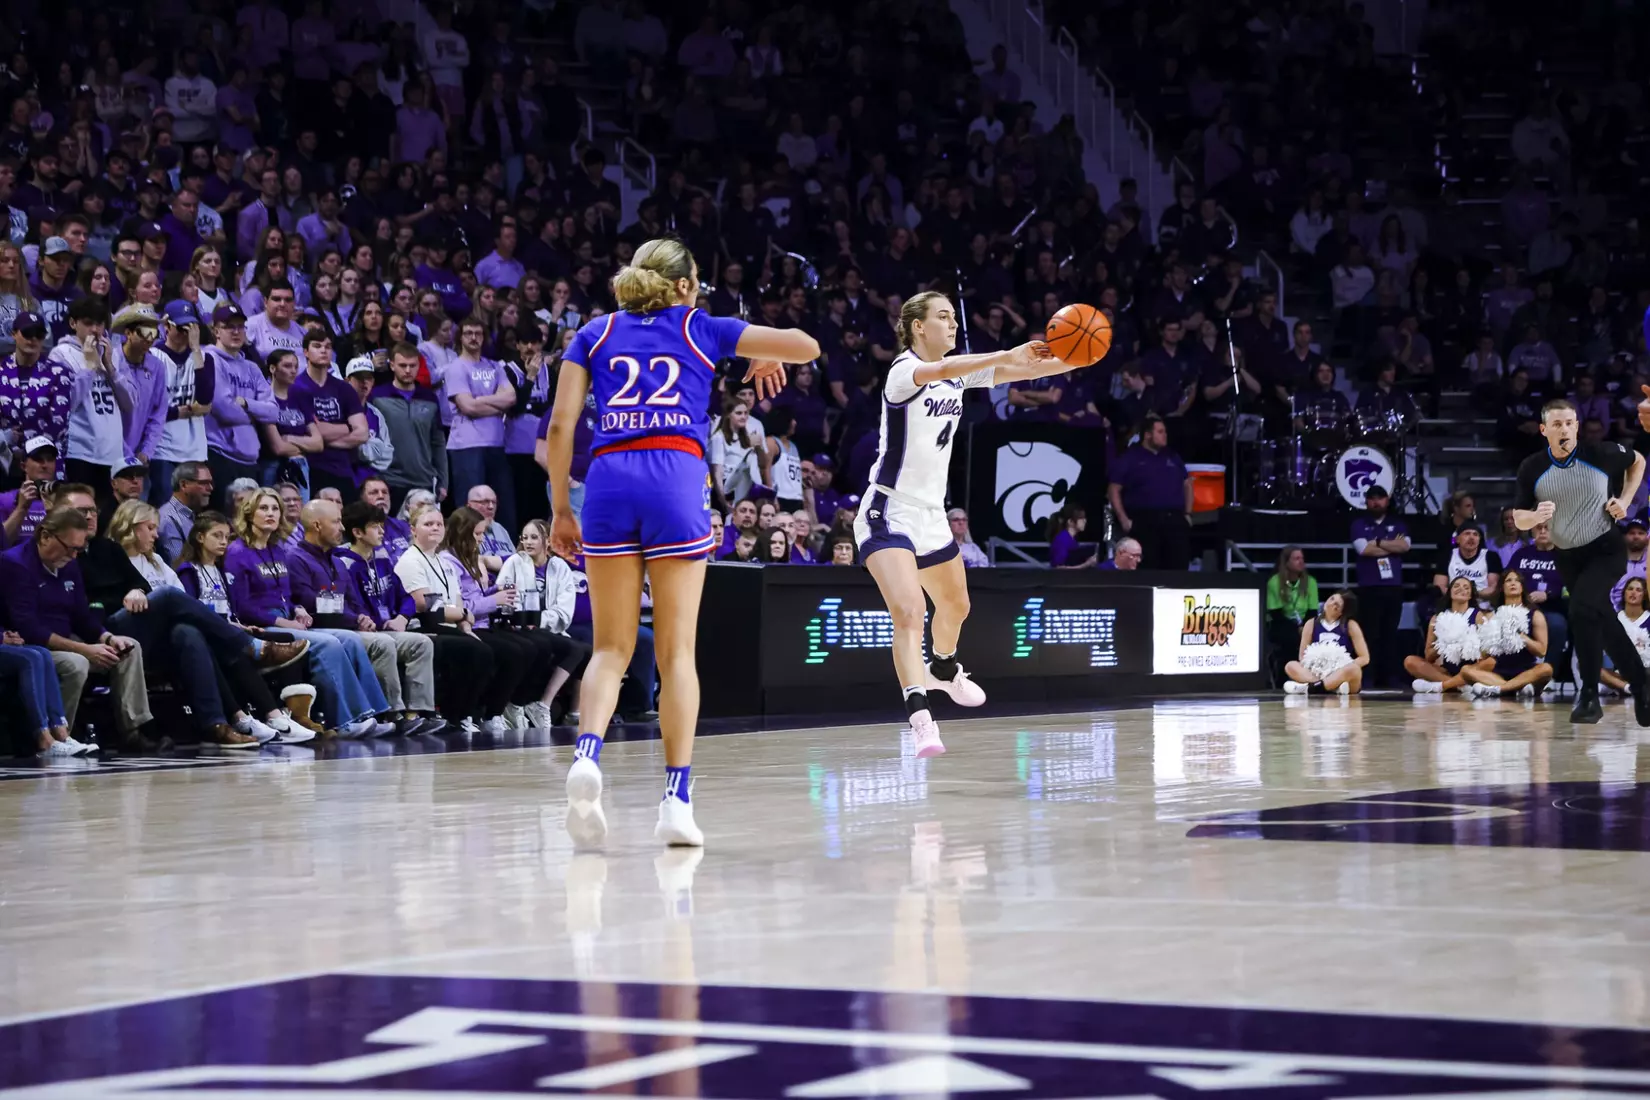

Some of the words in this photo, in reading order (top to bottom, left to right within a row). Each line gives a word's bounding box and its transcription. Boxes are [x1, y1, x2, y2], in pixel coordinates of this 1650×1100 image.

[606, 355, 681, 406] 22
[92, 391, 115, 415] 25
[601, 411, 691, 431] COPELAND
[936, 420, 952, 452] 4
[1181, 594, 1236, 647] Briggs
